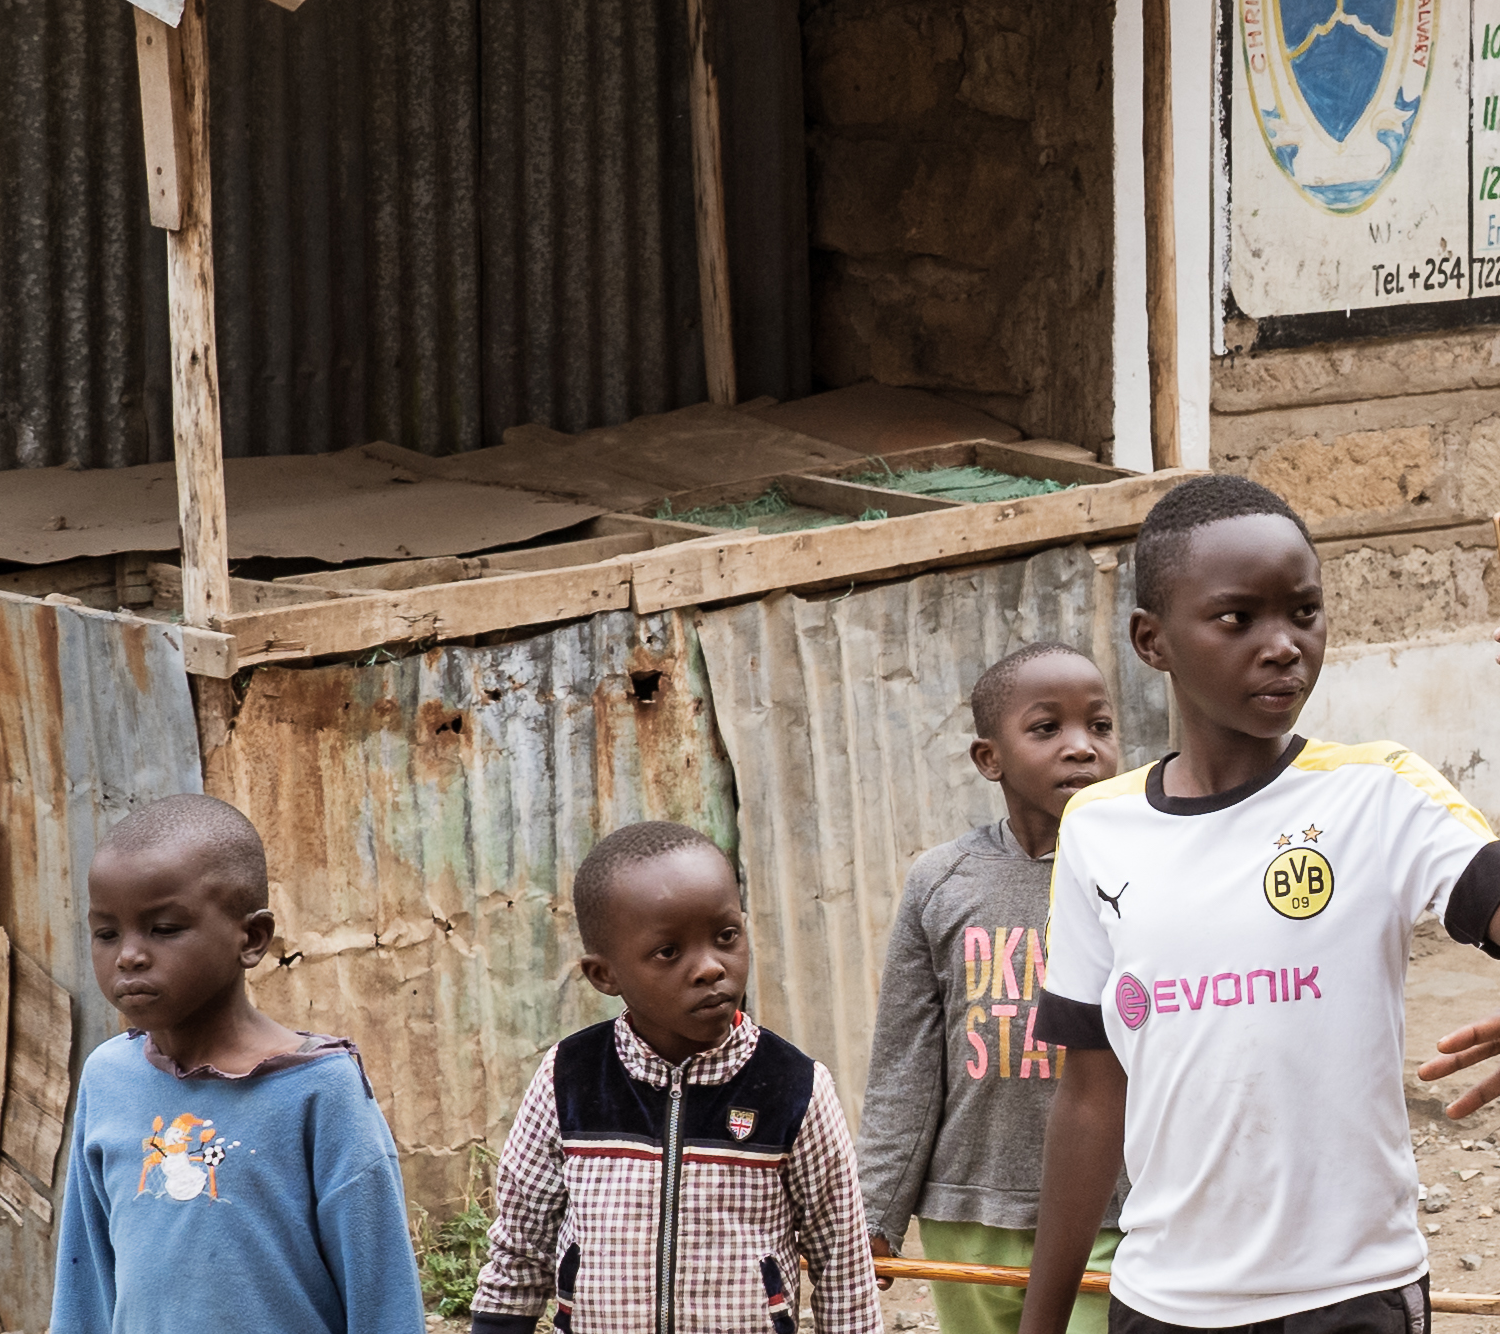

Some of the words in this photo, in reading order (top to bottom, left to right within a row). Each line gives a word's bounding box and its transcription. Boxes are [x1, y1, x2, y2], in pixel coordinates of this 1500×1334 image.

[1273, 855, 1325, 898] BVB
[1291, 896, 1310, 910] 09
[964, 926, 1047, 1001] DKN
[1153, 965, 1322, 1014] EVONIK
